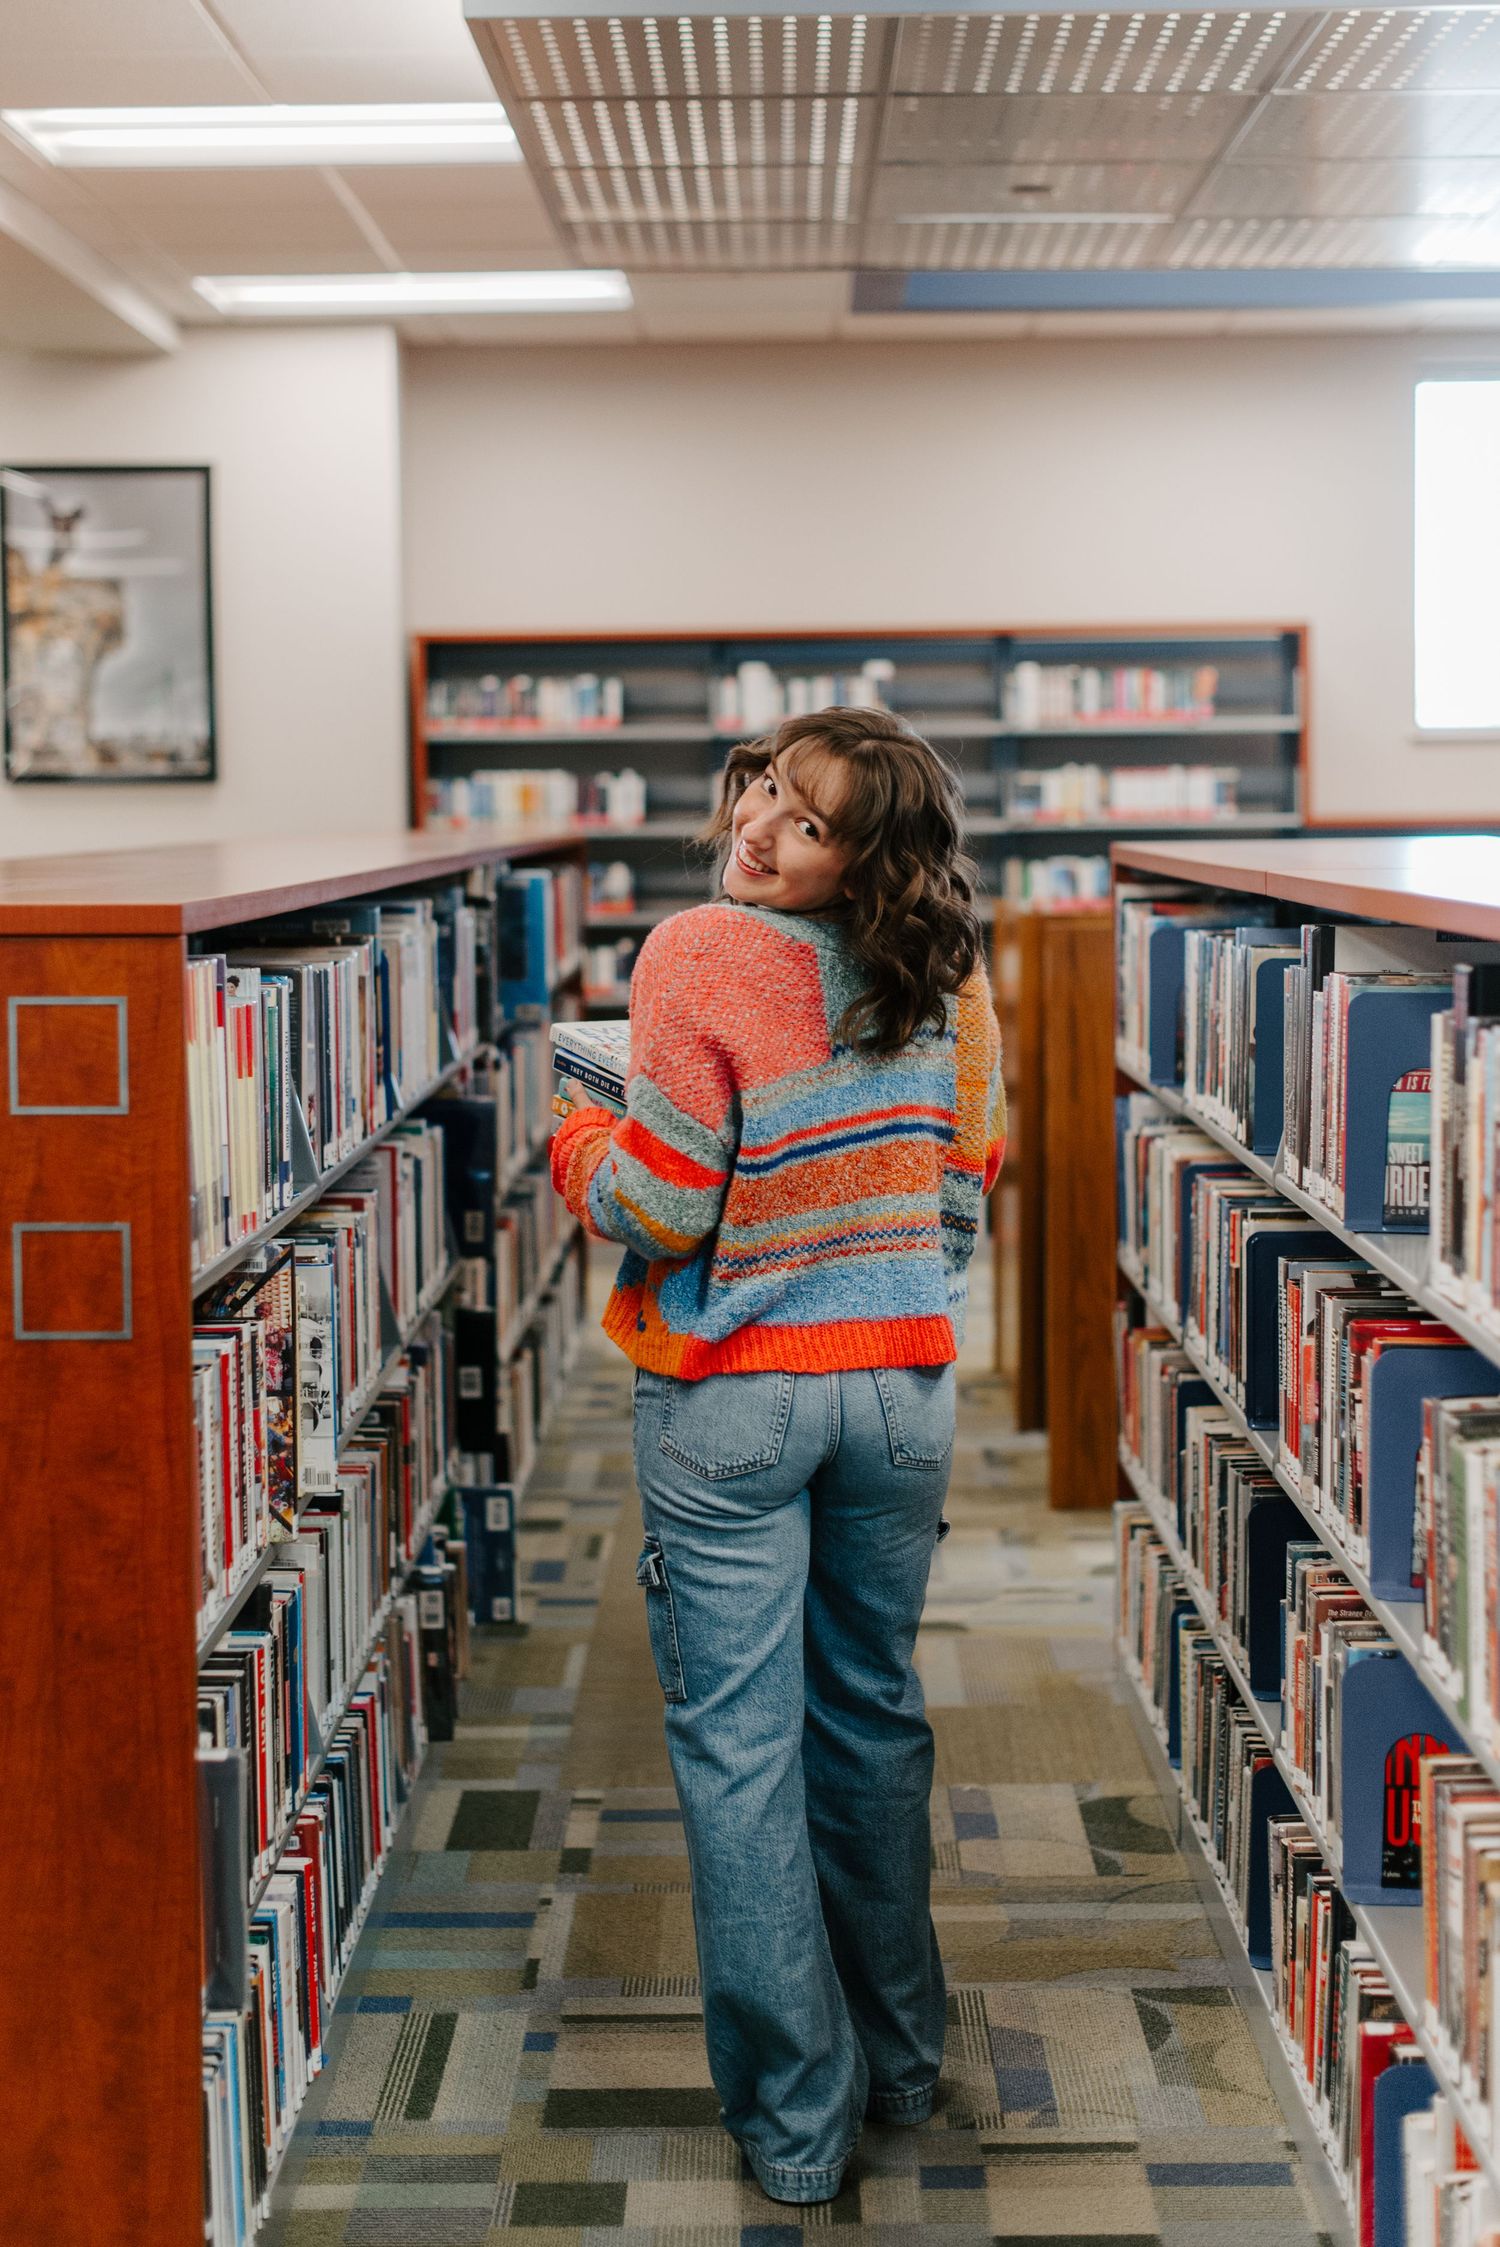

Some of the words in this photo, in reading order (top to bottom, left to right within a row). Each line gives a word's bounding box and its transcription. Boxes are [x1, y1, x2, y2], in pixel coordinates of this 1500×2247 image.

[558, 1032, 597, 1060] EVERYTHING
[598, 1052, 628, 1074] EVERYTH
[570, 1065, 583, 1076] THEY
[584, 1071, 599, 1084] BOTH
[600, 1078, 610, 1089] DIE
[611, 1085, 619, 1094] AT
[1406, 1076, 1419, 1090] IS
[1388, 1142, 1424, 1165] SWEET
[1384, 1165, 1430, 1208] RDE
[1328, 1609, 1338, 1617] The
[1339, 1608, 1363, 1618] Strange
